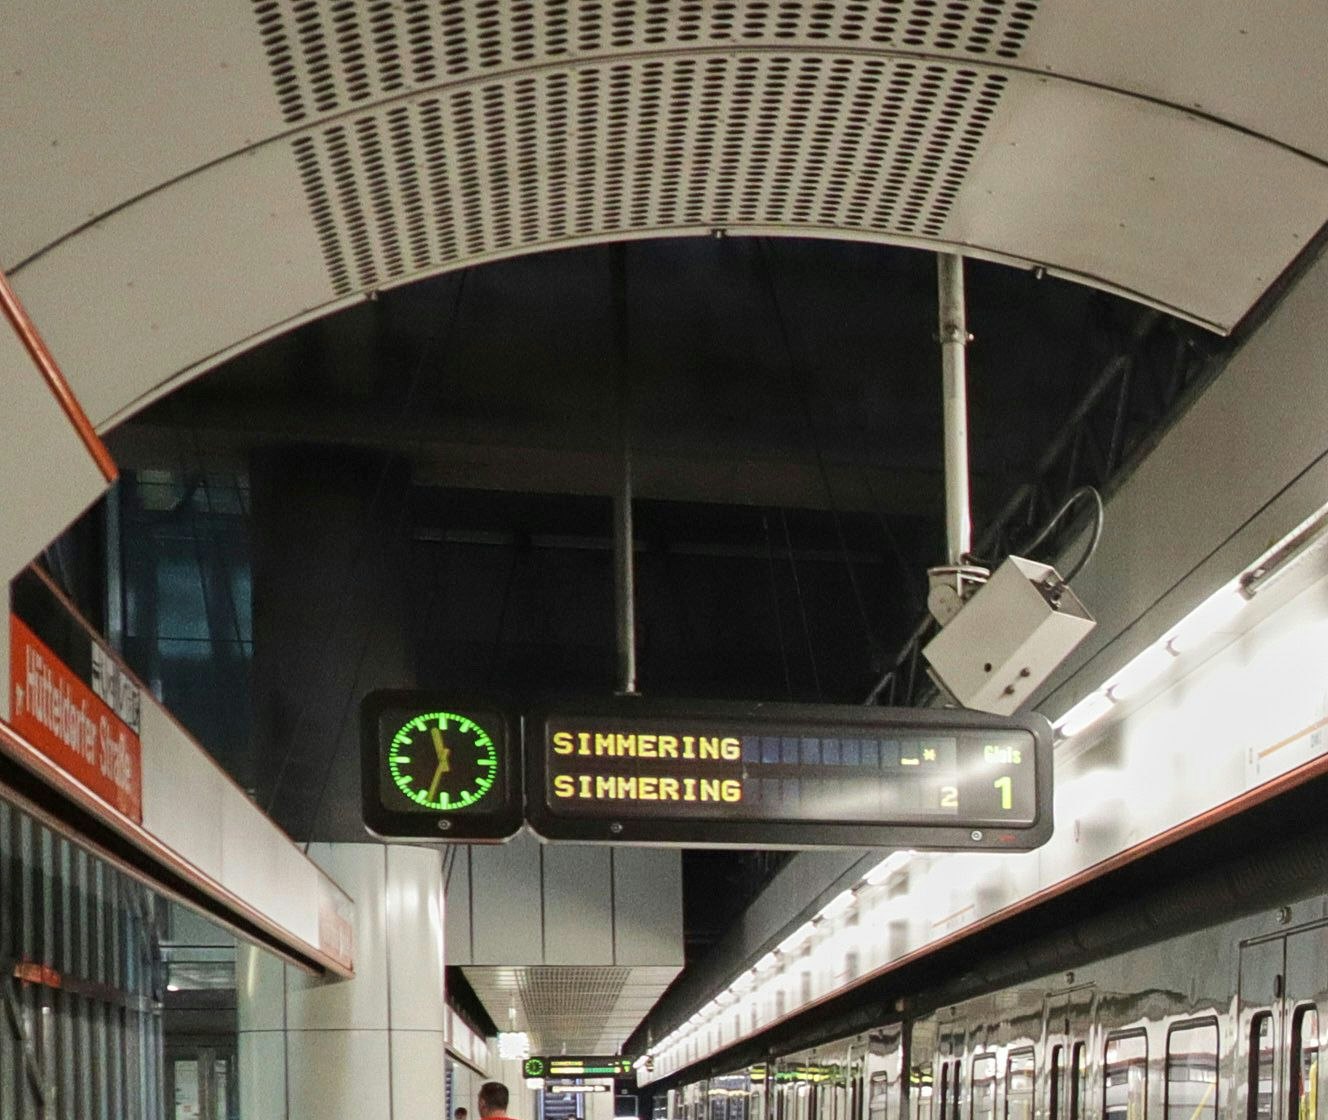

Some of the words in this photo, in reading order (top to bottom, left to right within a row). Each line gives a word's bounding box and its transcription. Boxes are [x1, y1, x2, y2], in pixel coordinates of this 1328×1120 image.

[553, 732, 741, 760] SIMMERING
[554, 775, 742, 802] SIMMERING
[940, 786, 959, 807] 2
[994, 776, 1012, 810] 1
